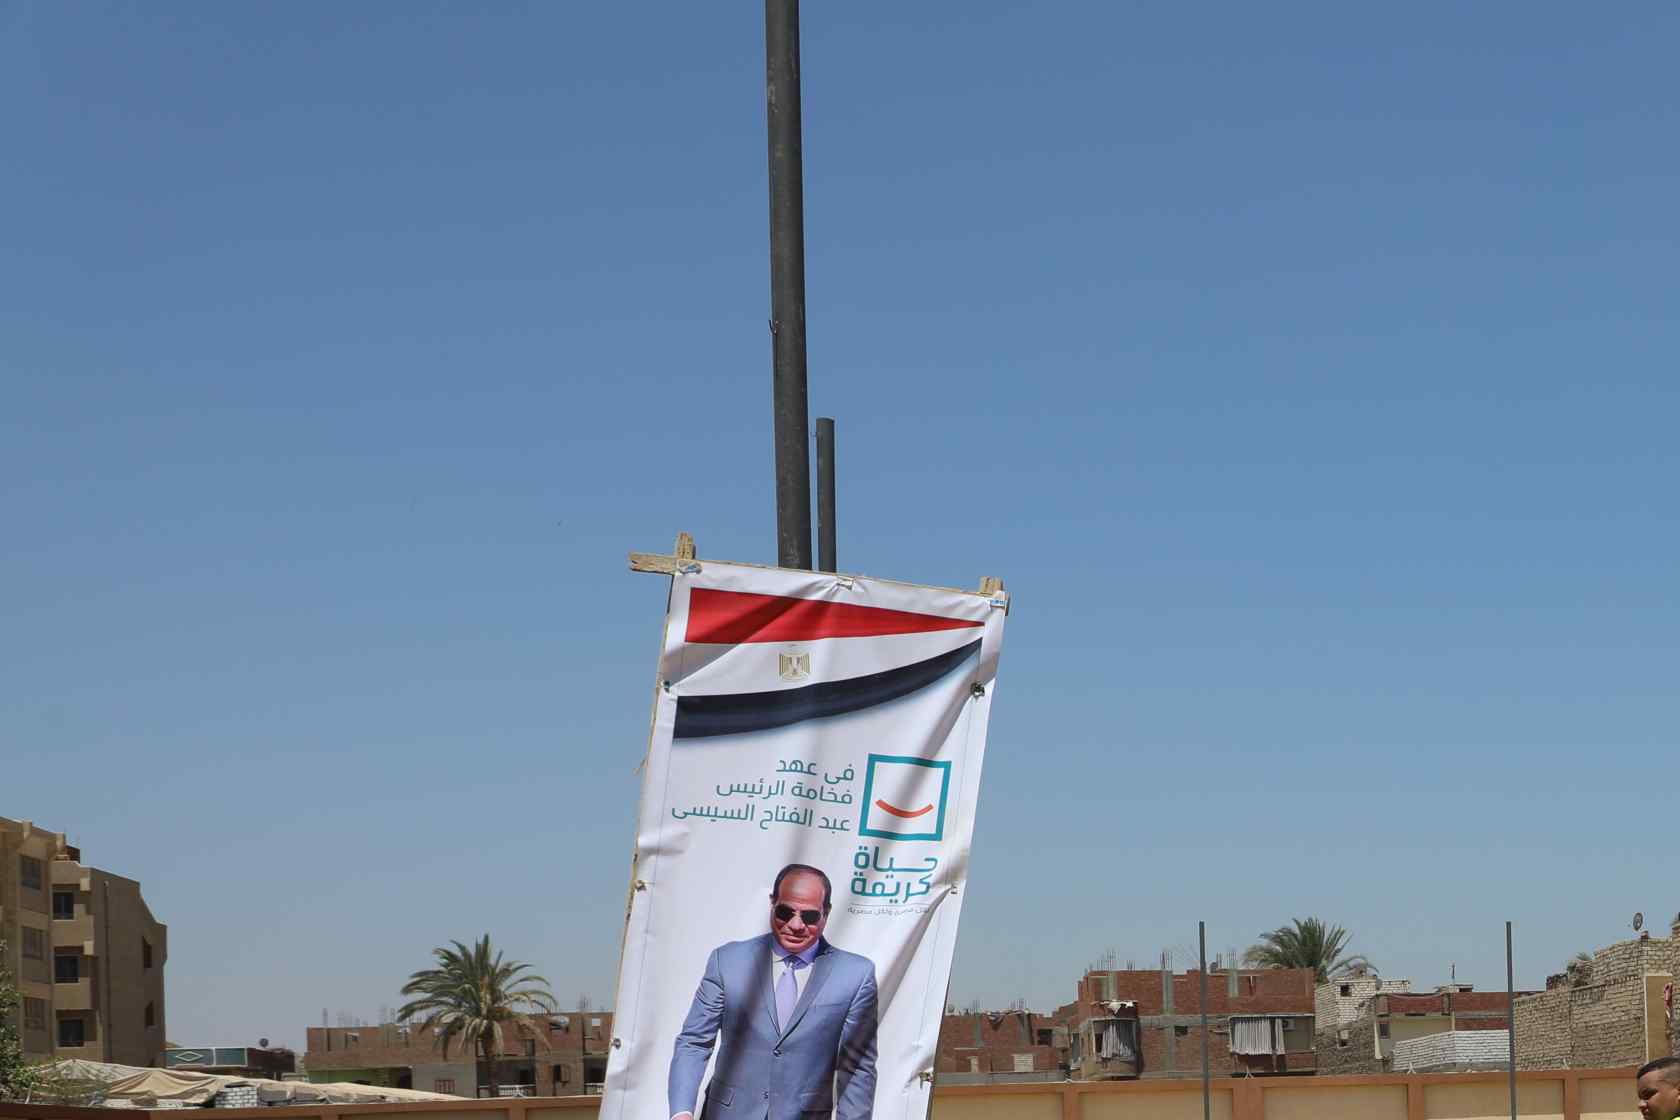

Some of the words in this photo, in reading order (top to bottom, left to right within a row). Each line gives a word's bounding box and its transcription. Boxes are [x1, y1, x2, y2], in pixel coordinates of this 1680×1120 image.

[776, 759, 817, 776] عهد
[716, 778, 786, 799] الرئيس
[791, 781, 853, 805] فخامة
[759, 804, 814, 830] الفتاح
[818, 815, 851, 834] عبد
[853, 846, 939, 879] حياة
[851, 871, 934, 904] كريمة
